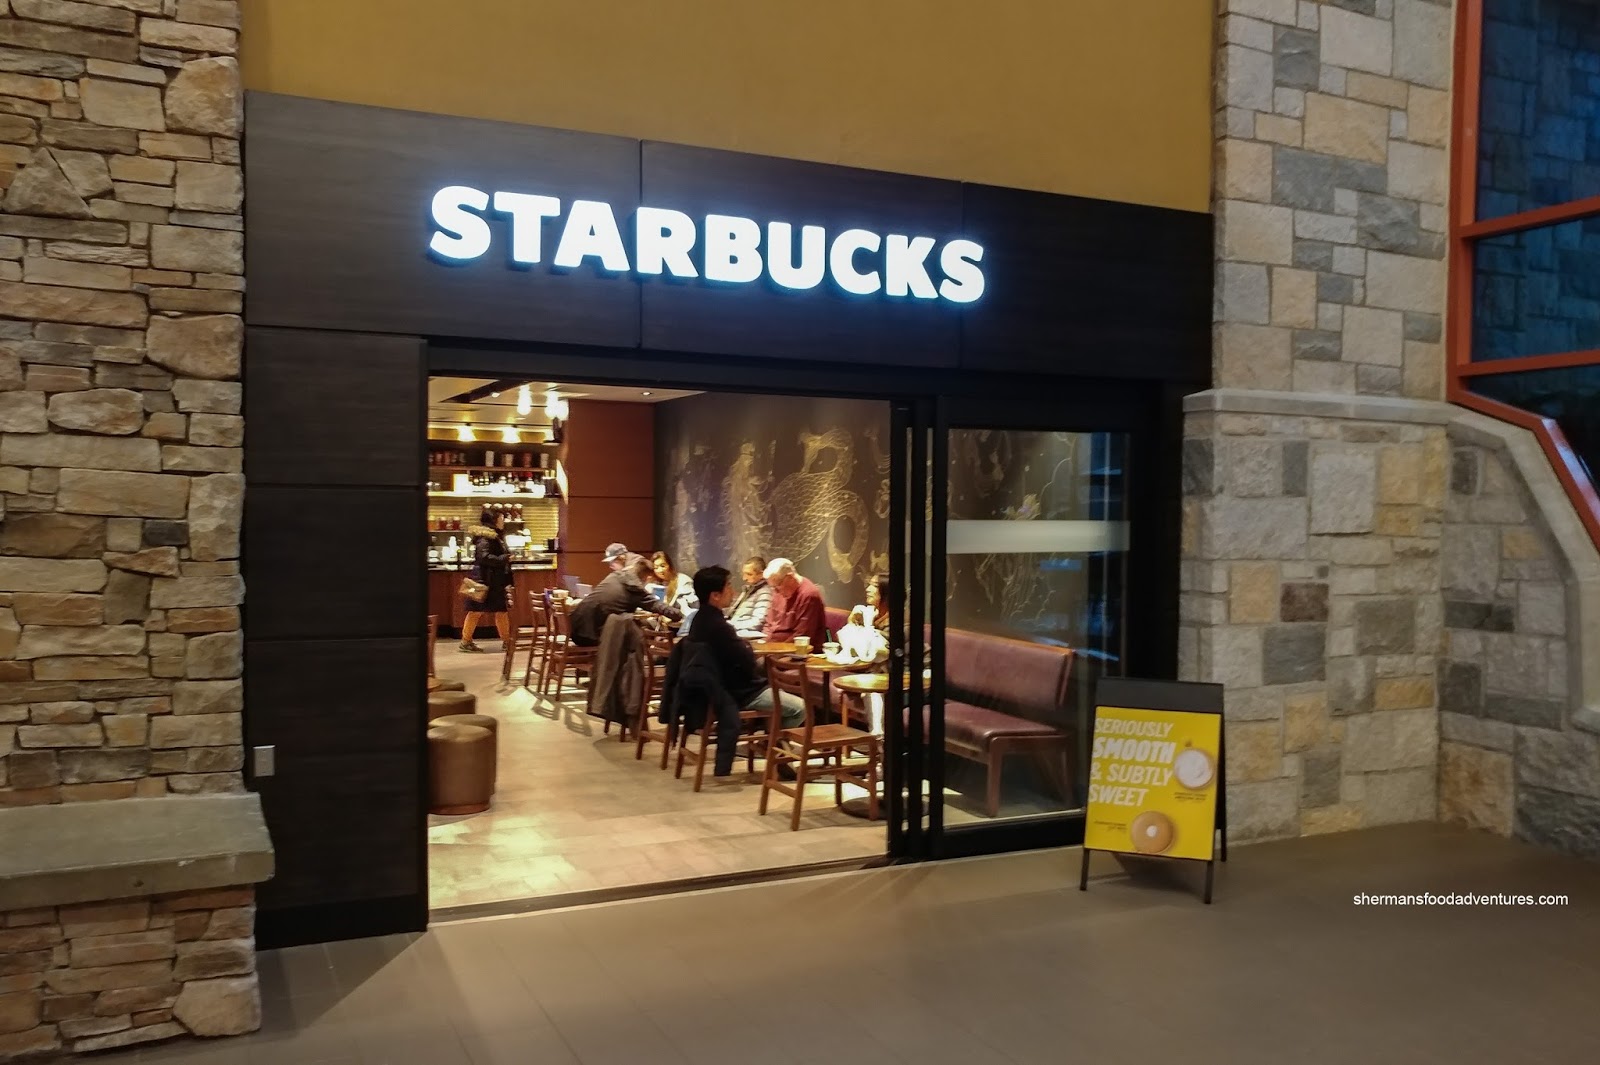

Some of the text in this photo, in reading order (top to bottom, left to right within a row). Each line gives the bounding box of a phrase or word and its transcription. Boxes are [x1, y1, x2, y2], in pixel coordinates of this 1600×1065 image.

[430, 185, 986, 303] STARBUCKS
[1095, 718, 1173, 737] SERIOUSLY
[1092, 738, 1176, 763] SMOOTH
[1107, 764, 1173, 786] SUBTLY
[1088, 784, 1148, 806] SWEET
